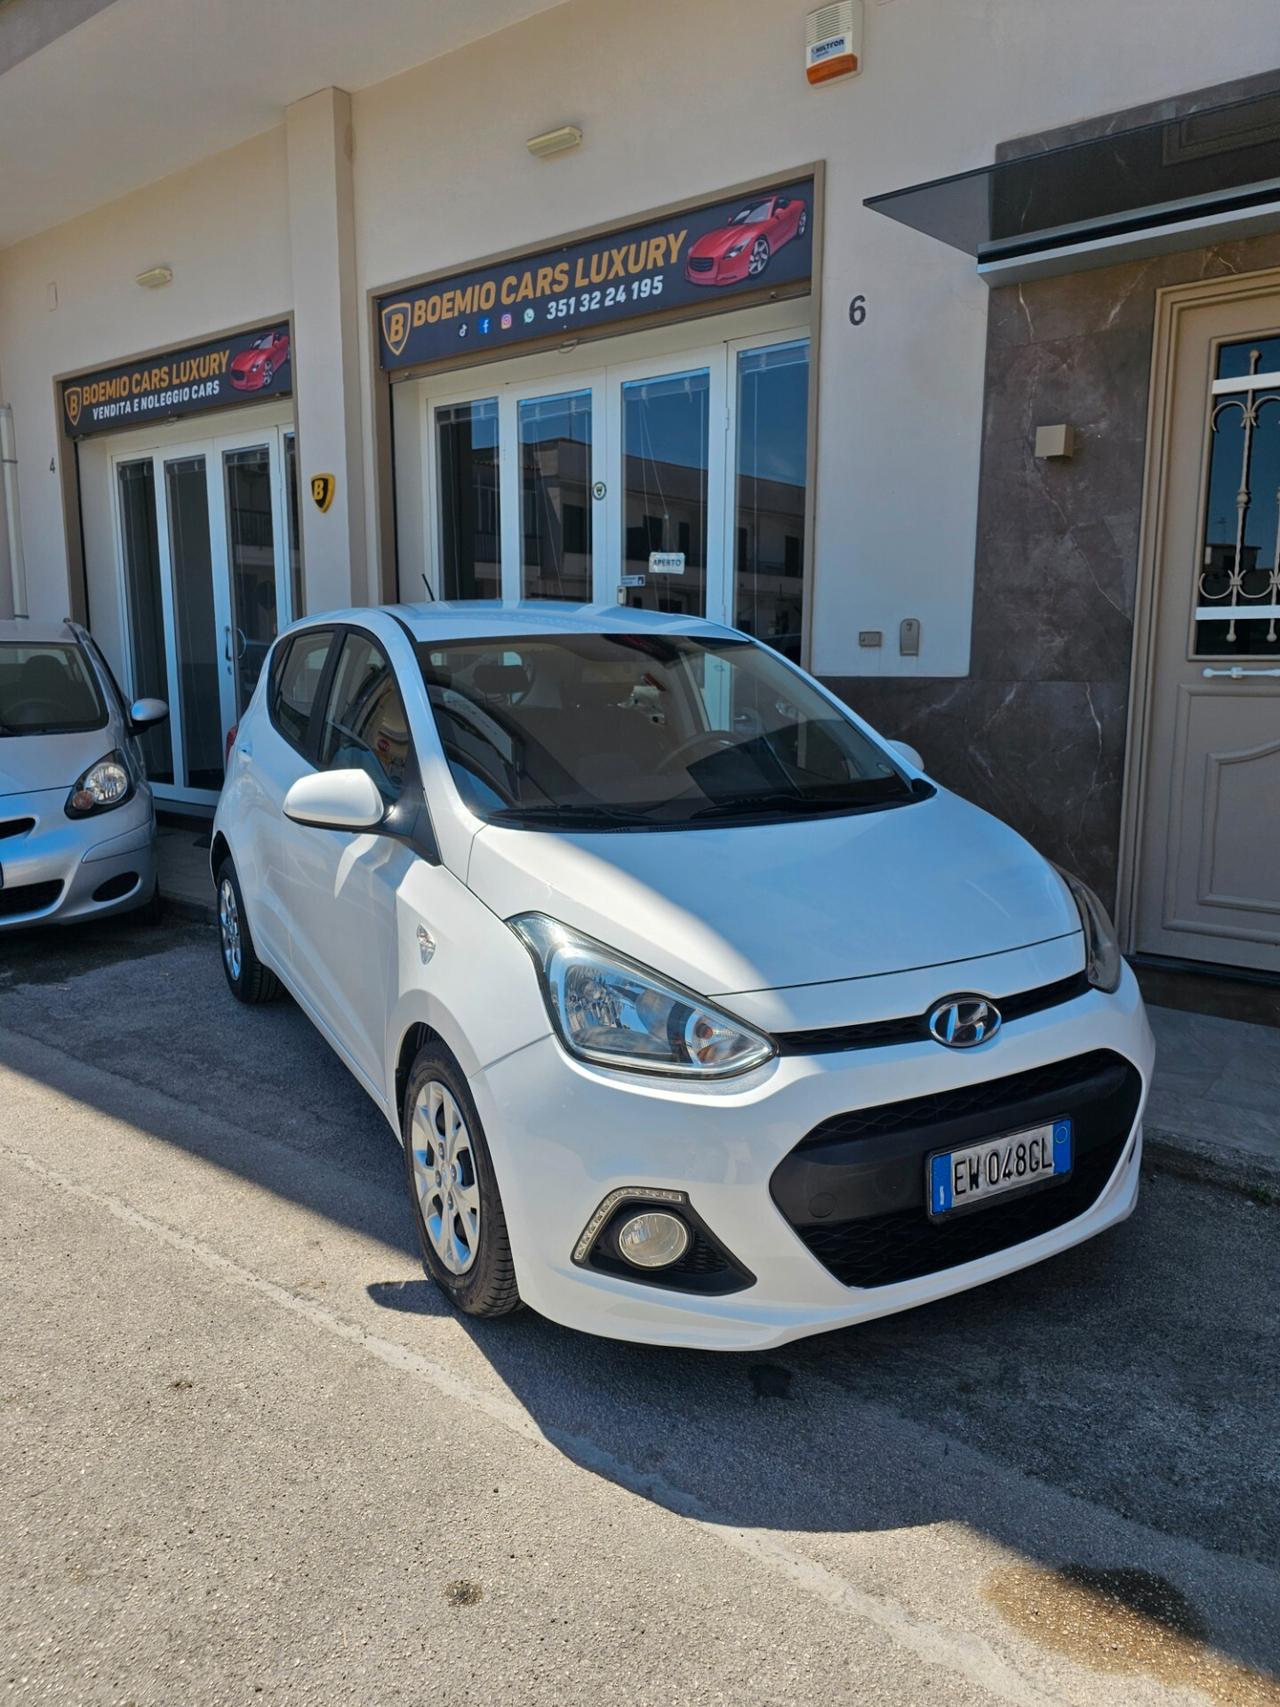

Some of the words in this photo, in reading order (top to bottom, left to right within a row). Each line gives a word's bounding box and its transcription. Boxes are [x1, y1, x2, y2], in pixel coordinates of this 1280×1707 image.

[413, 281, 496, 327] BOEMIO
[501, 262, 570, 305] CARS
[575, 229, 688, 288] LUXURY
[546, 297, 576, 319] 351
[579, 291, 601, 312] 32
[604, 285, 626, 307] 24
[631, 275, 663, 300] 195
[848, 294, 866, 326] 6
[389, 313, 404, 343] B
[83, 375, 129, 406] BOEMIO
[132, 366, 169, 394] CARS
[172, 350, 230, 386] LUXURY
[70, 395, 78, 417] B
[92, 401, 132, 421] VENDITA
[134, 399, 139, 412] E
[140, 388, 189, 410] NOLEGGIO
[191, 380, 220, 399] CARS
[49, 457, 56, 474] 4
[313, 479, 324, 500] B
[653, 559, 681, 568] APERTO
